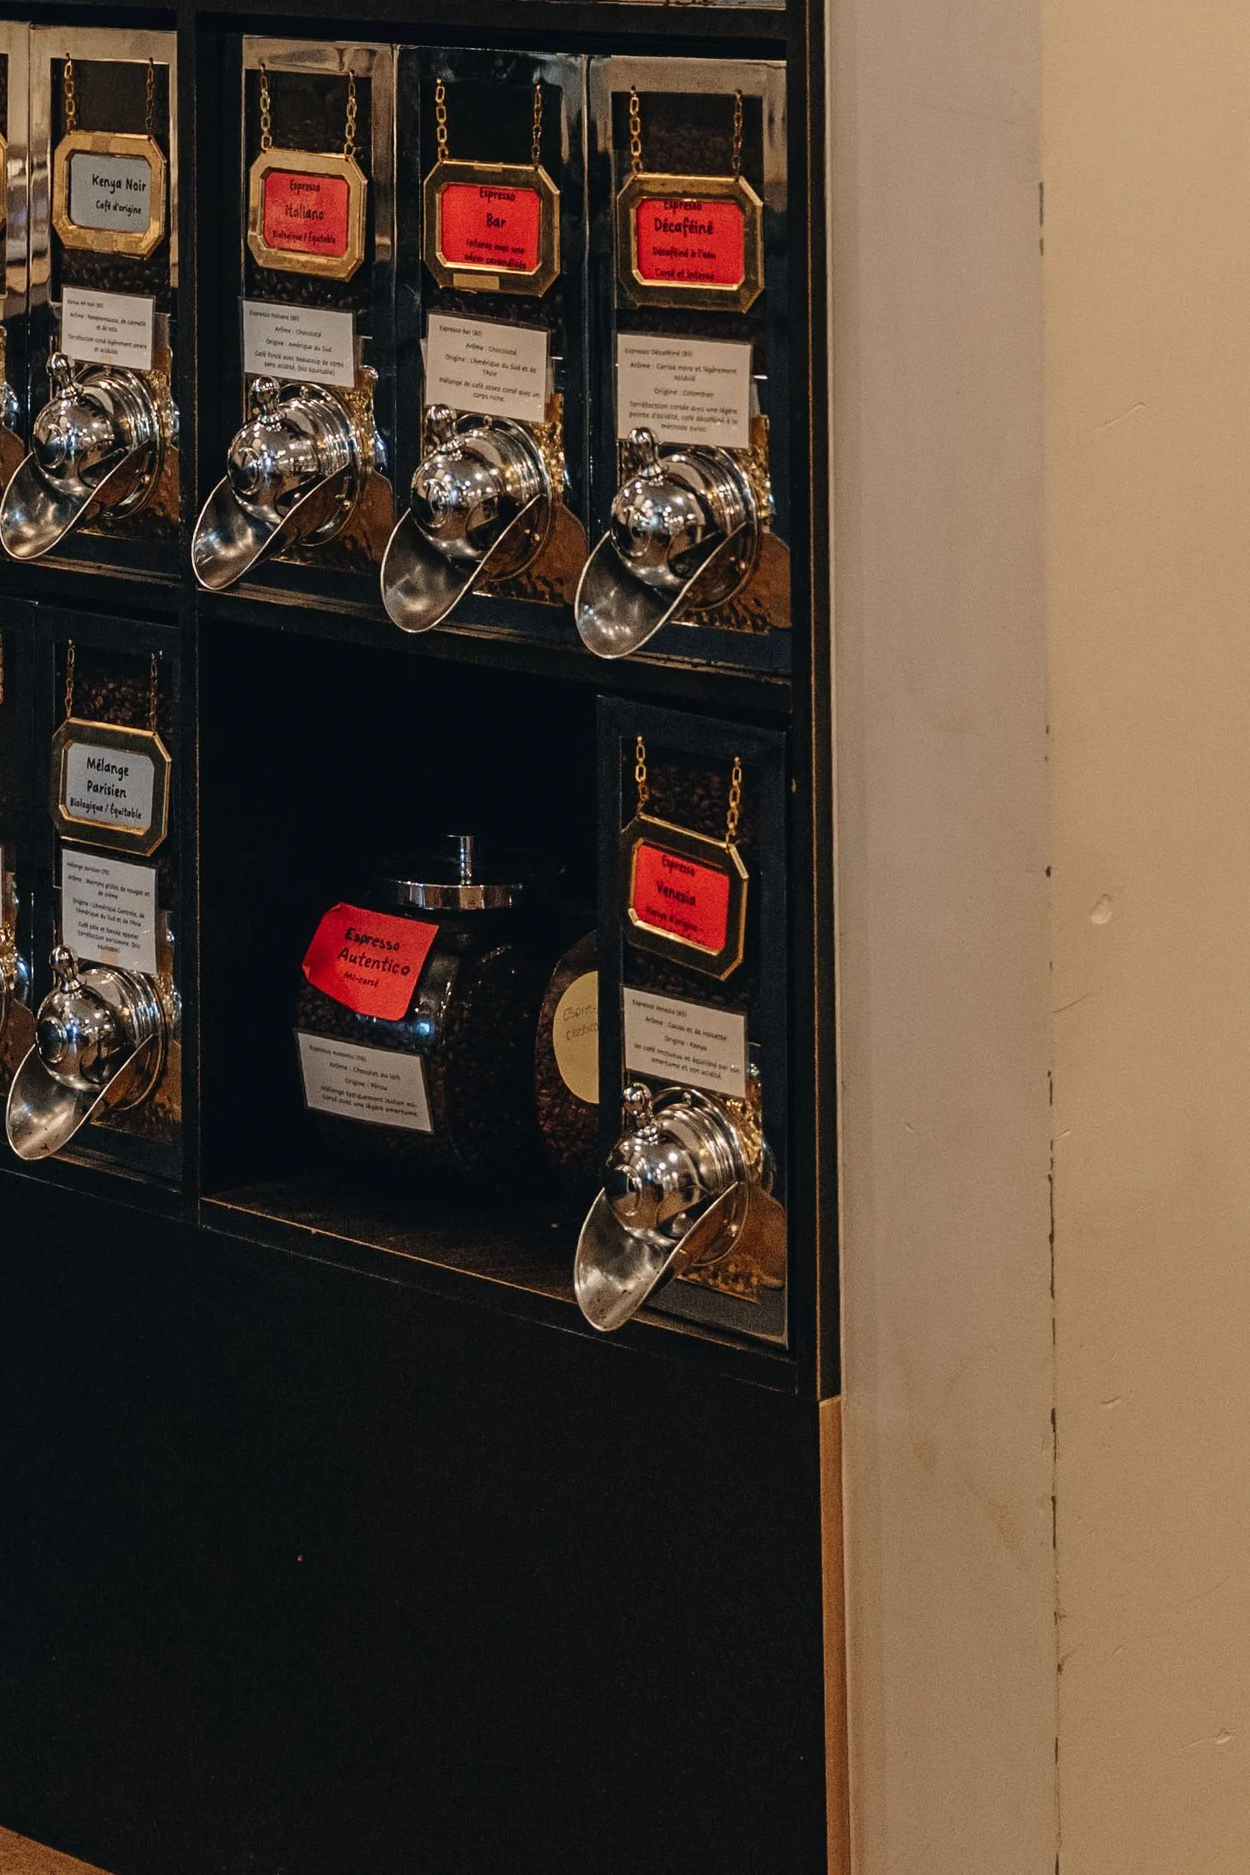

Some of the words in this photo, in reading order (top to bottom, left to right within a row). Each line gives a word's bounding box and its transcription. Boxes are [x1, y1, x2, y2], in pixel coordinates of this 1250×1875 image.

[92, 173, 121, 194] Kenya
[125, 178, 147, 192] Noir
[290, 179, 320, 195] Espresso
[480, 187, 516, 203] Espresso
[95, 200, 111, 212] Café
[112, 201, 141, 217] d'origine
[486, 212, 506, 229] Bar
[654, 217, 713, 237] Décaféiné
[86, 757, 129, 781] Mélange
[87, 779, 126, 798] Parisien
[70, 797, 103, 814] Biologique
[110, 802, 141, 820] Équitable
[656, 881, 696, 906] Venezia
[344, 927, 400, 952] Espresso
[338, 947, 411, 976] Autentico
